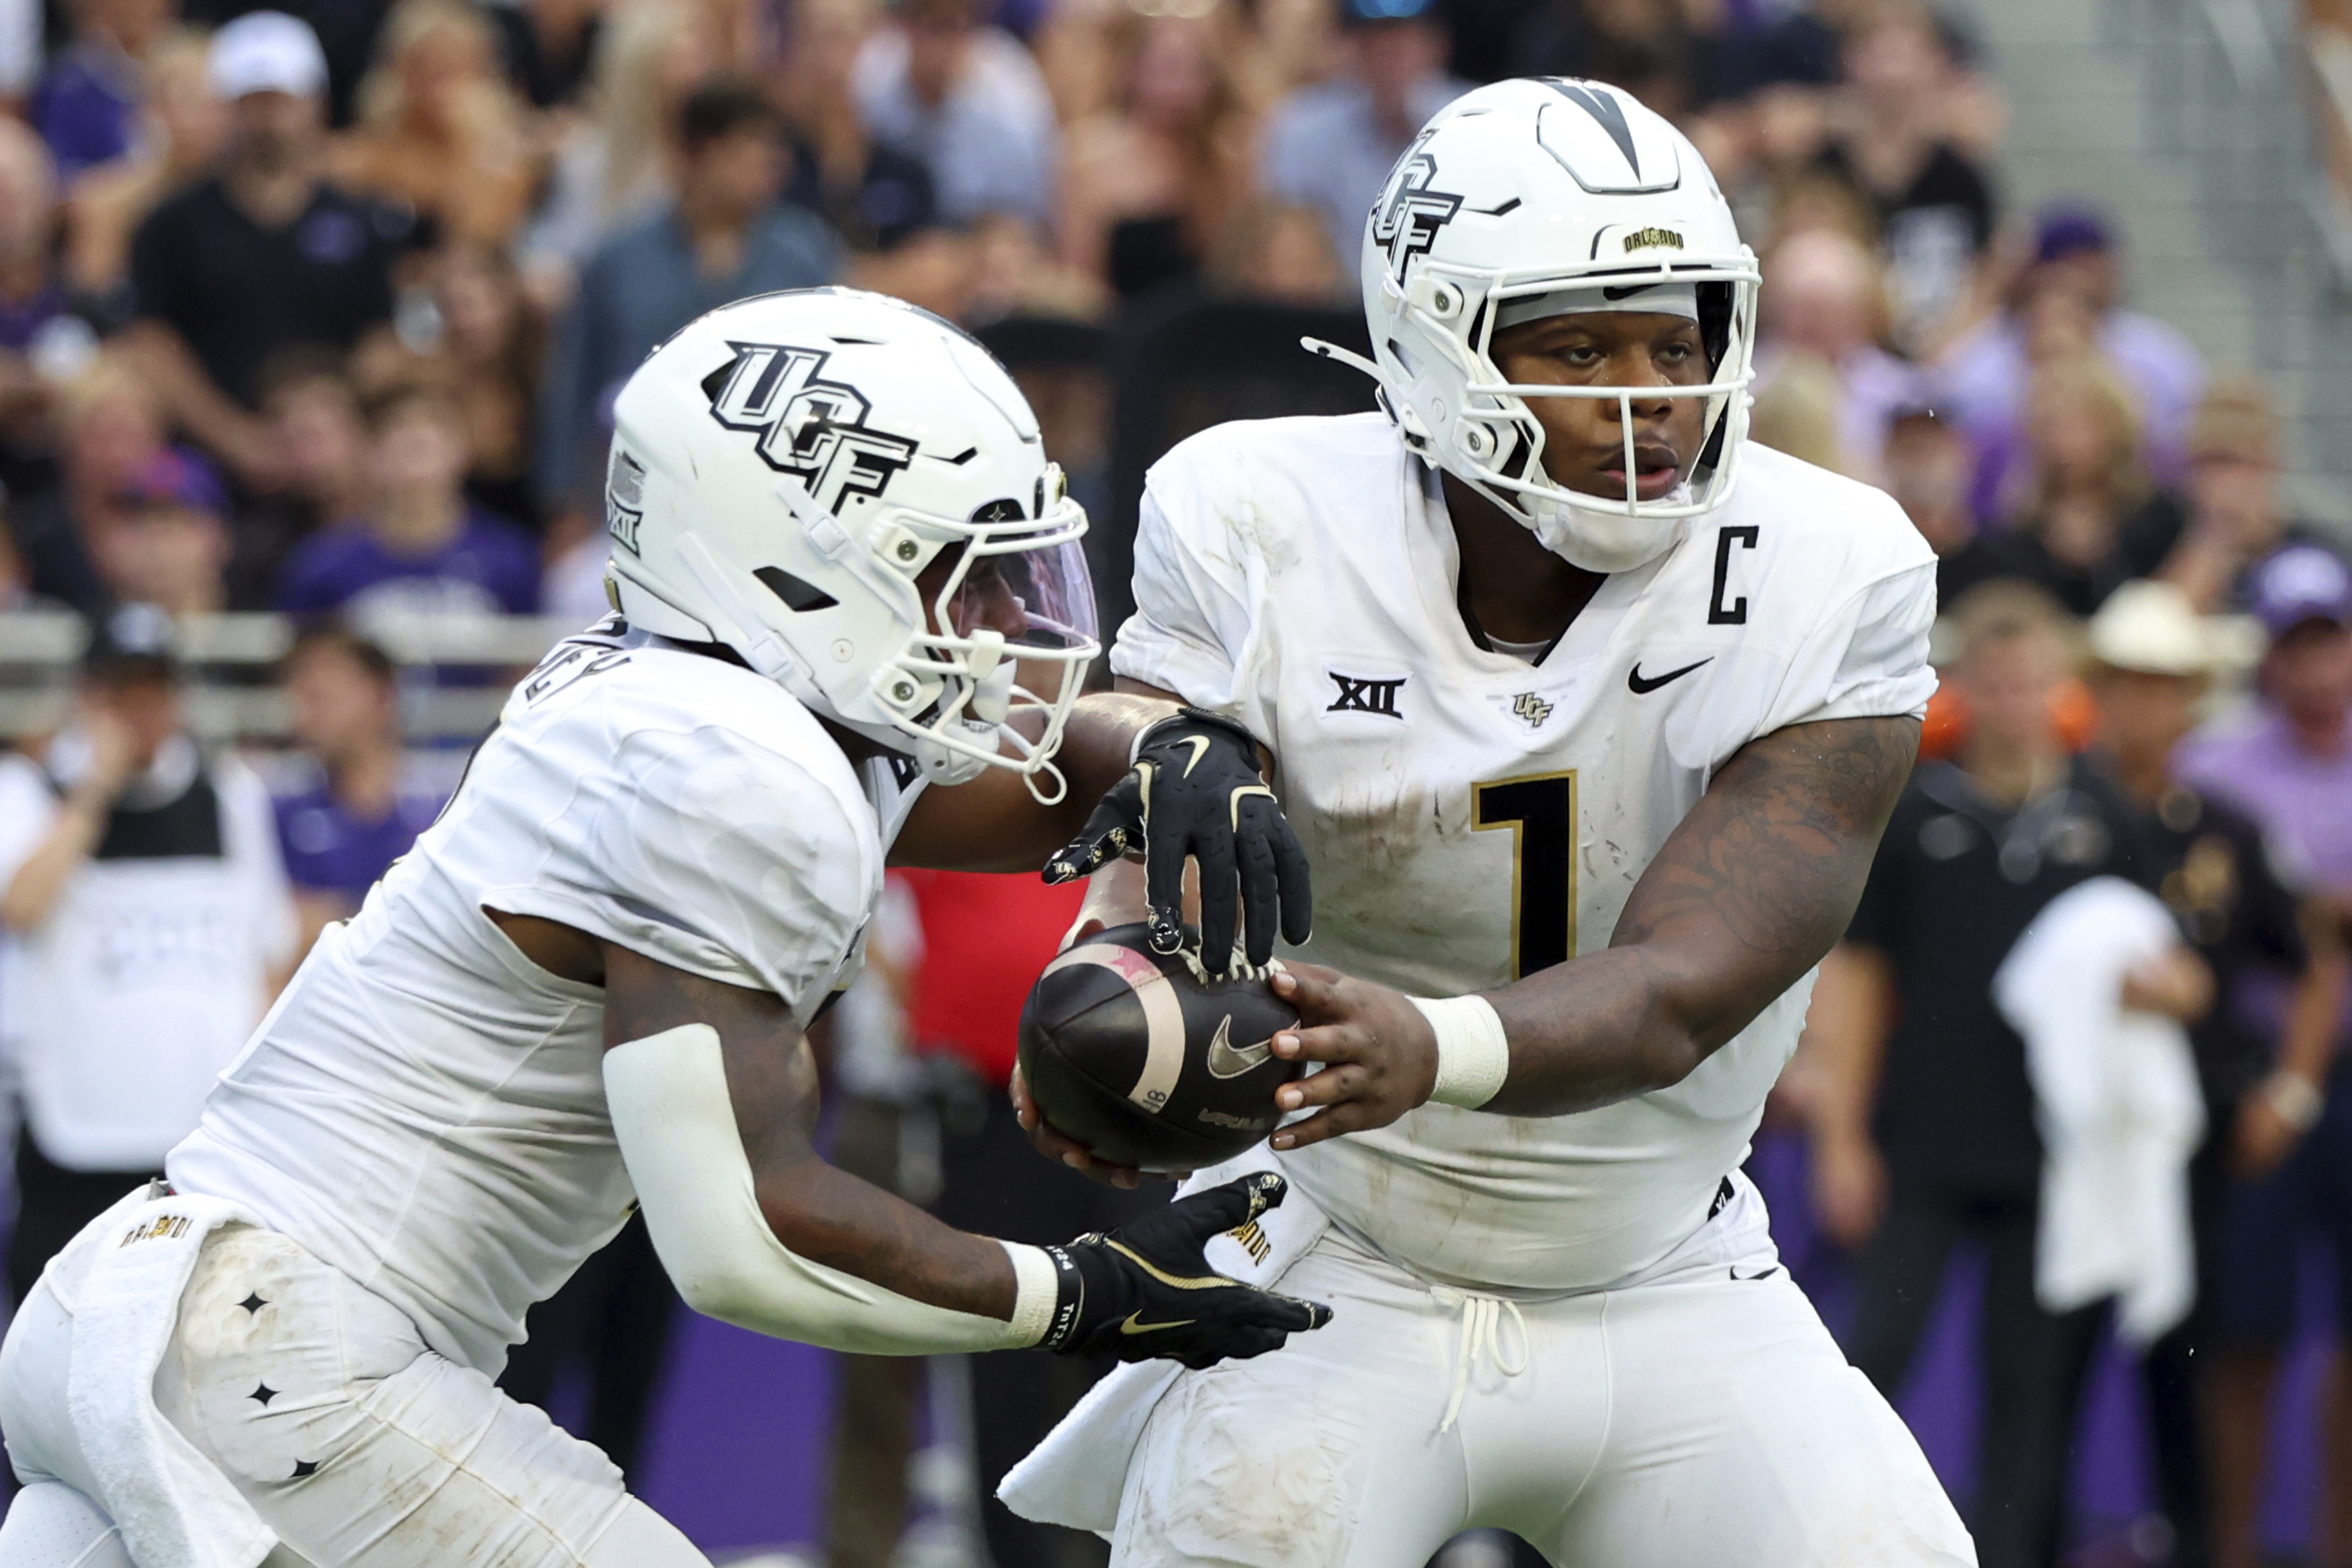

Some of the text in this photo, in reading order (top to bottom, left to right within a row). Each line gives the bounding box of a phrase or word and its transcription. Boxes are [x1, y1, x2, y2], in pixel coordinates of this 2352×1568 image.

[709, 340, 920, 517] UCF
[1708, 525, 1759, 624] C
[1327, 671, 1407, 720] XII
[1511, 692, 1554, 727] UCF
[1471, 769, 1578, 982] 1
